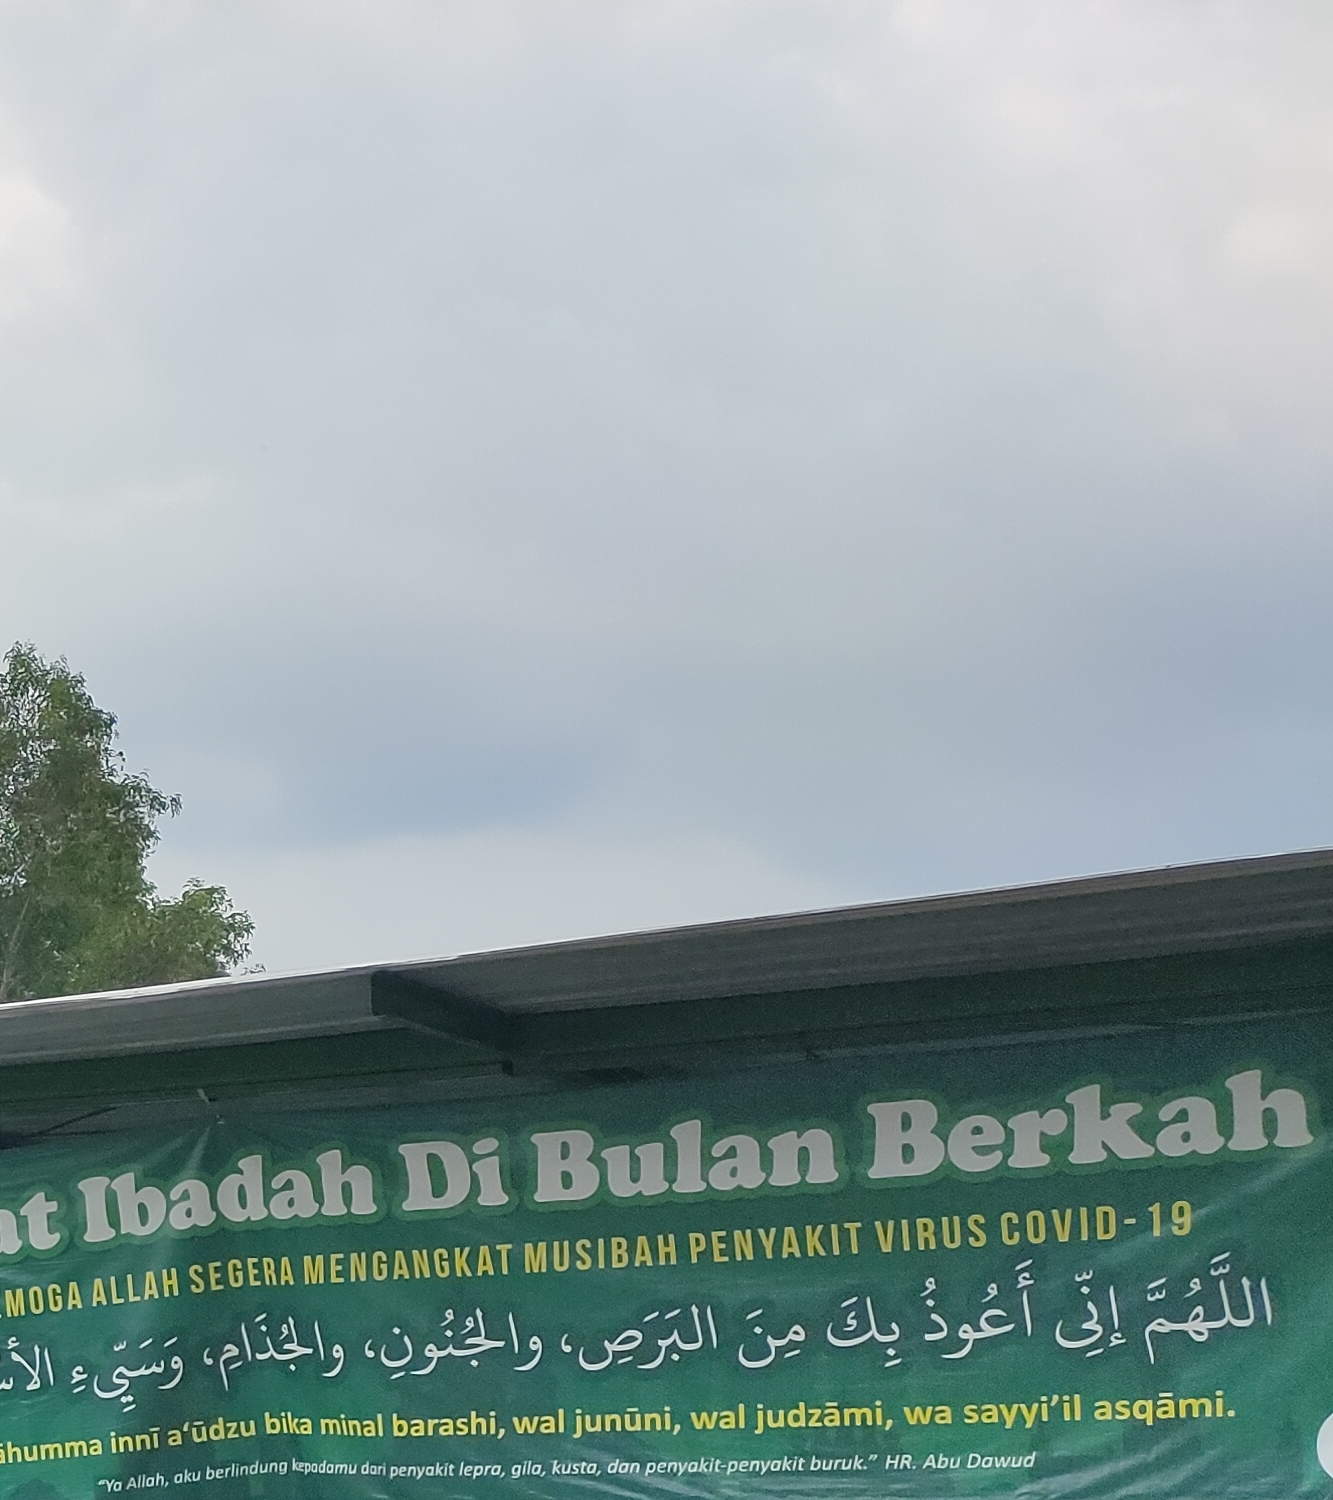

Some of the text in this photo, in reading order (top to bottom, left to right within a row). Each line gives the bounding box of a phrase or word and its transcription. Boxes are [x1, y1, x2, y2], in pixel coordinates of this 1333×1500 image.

[77, 1149, 378, 1243] Ibadah
[397, 1137, 510, 1212] Di
[530, 1119, 840, 1203] Bulan
[866, 1069, 1315, 1179] Berkah
[92, 1267, 179, 1307] ALLAH
[188, 1257, 295, 1294] SEGERA
[303, 1243, 513, 1285] MENGANGKAT
[524, 1233, 677, 1274] MUSIBAH
[688, 1221, 862, 1264] PENYAKIT
[874, 1214, 987, 1253] VIRUS
[264, 1411, 313, 1435] bika
[320, 1413, 384, 1437] minal
[392, 1410, 506, 1440] barashi,
[512, 1408, 565, 1434] wal
[690, 1403, 746, 1430] wal
[903, 1405, 953, 1425] wa
[125, 1472, 169, 1490] Allah,
[173, 1468, 201, 1484] aku
[205, 1460, 288, 1480] berlindung
[291, 1457, 358, 1475] kepadamu
[360, 1460, 387, 1476] dari
[389, 1461, 455, 1480] penyakit
[458, 1461, 506, 1480] lepra,
[511, 1460, 547, 1479] gila,
[551, 1459, 602, 1477] kusta,
[607, 1458, 641, 1474] dan
[644, 1455, 806, 1478] penyakit-penyakit
[885, 1454, 917, 1470] HR.
[922, 1453, 961, 1470] Abu
[966, 1450, 1037, 1469] Dawud
